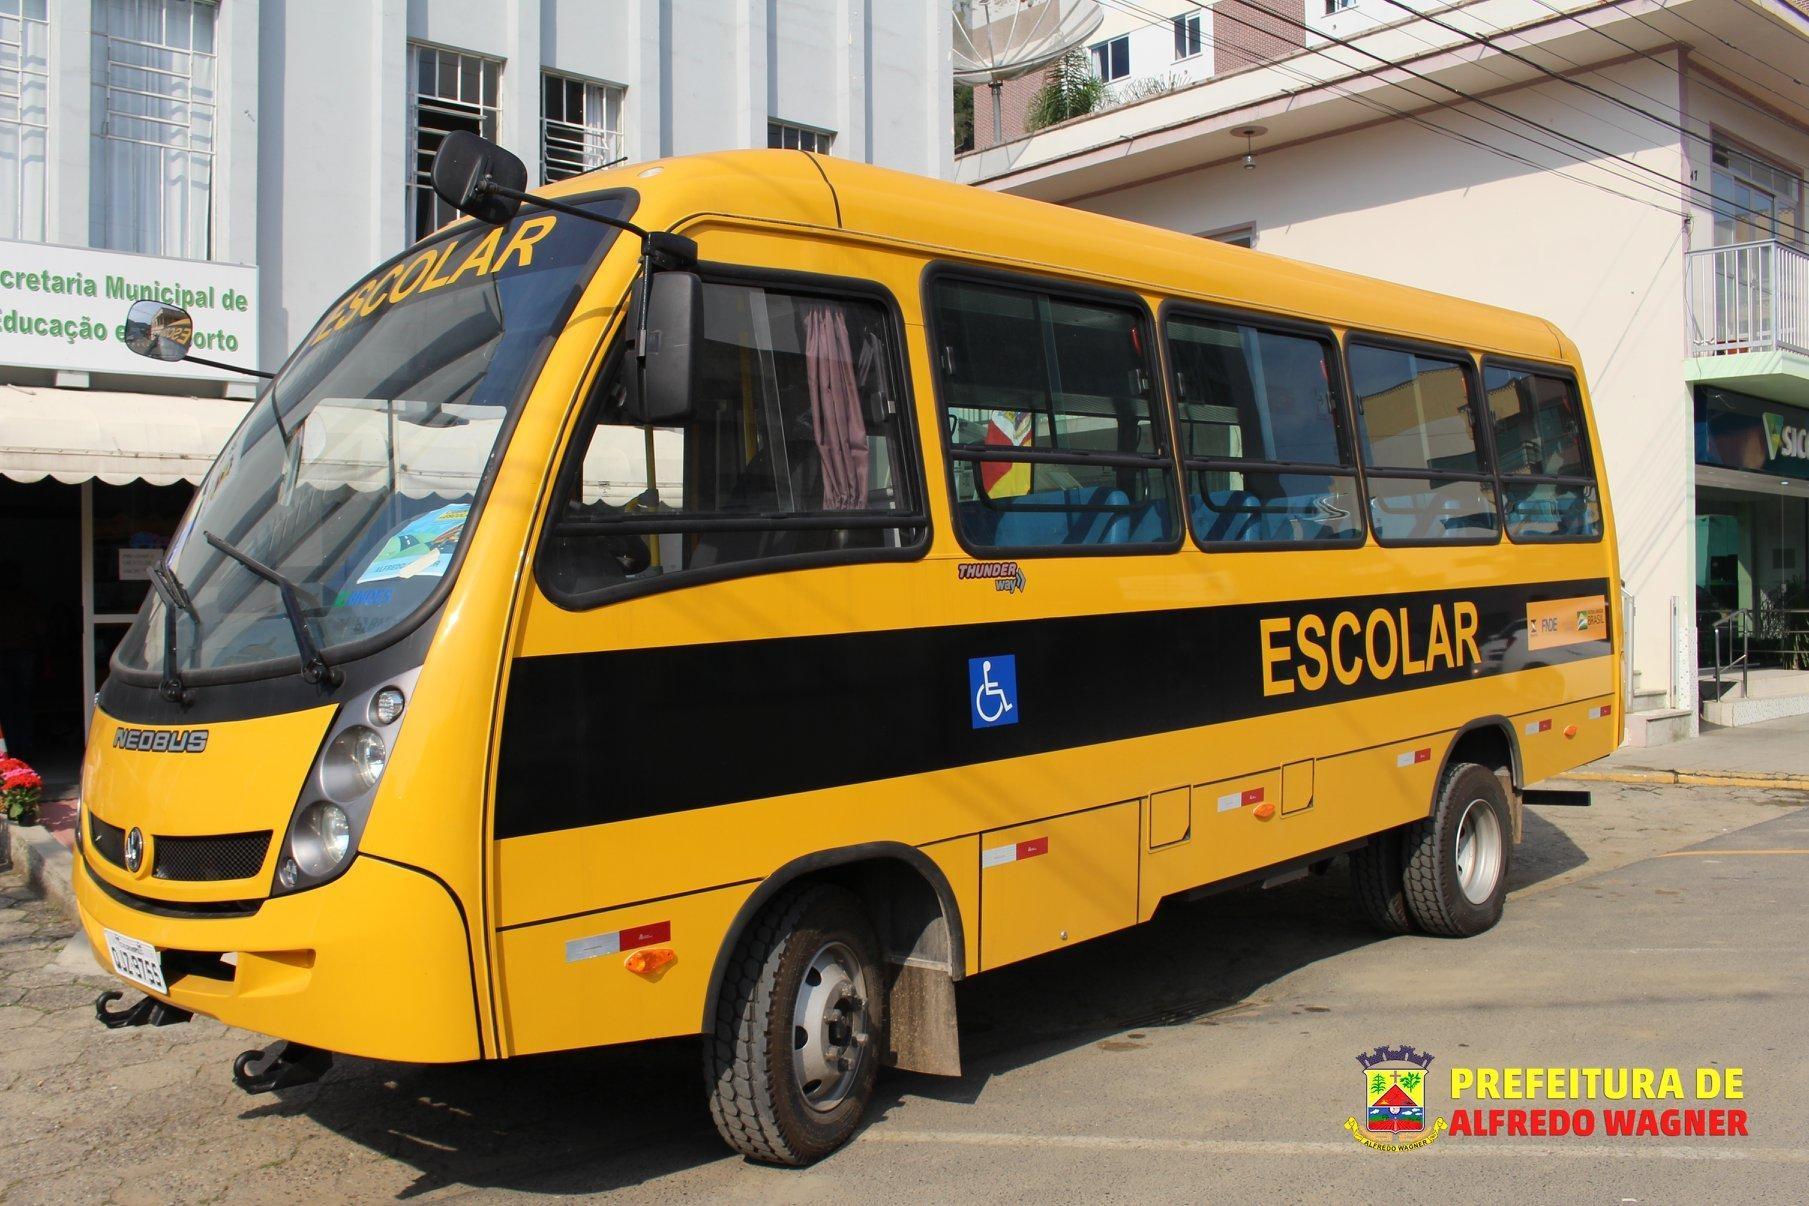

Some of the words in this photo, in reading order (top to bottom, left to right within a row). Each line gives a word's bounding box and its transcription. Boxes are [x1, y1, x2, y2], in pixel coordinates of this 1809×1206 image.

[0, 269, 97, 297] cretaria
[105, 275, 215, 310] Municipal
[222, 288, 248, 313] de
[307, 215, 557, 347] ESCOLAR
[0, 308, 107, 344] ducação
[1781, 425, 1809, 460] SIC
[958, 562, 1017, 579] THUNDER
[995, 578, 1017, 594] way
[1260, 601, 1482, 697] ESCOLAR
[112, 726, 210, 754] NEOBUS
